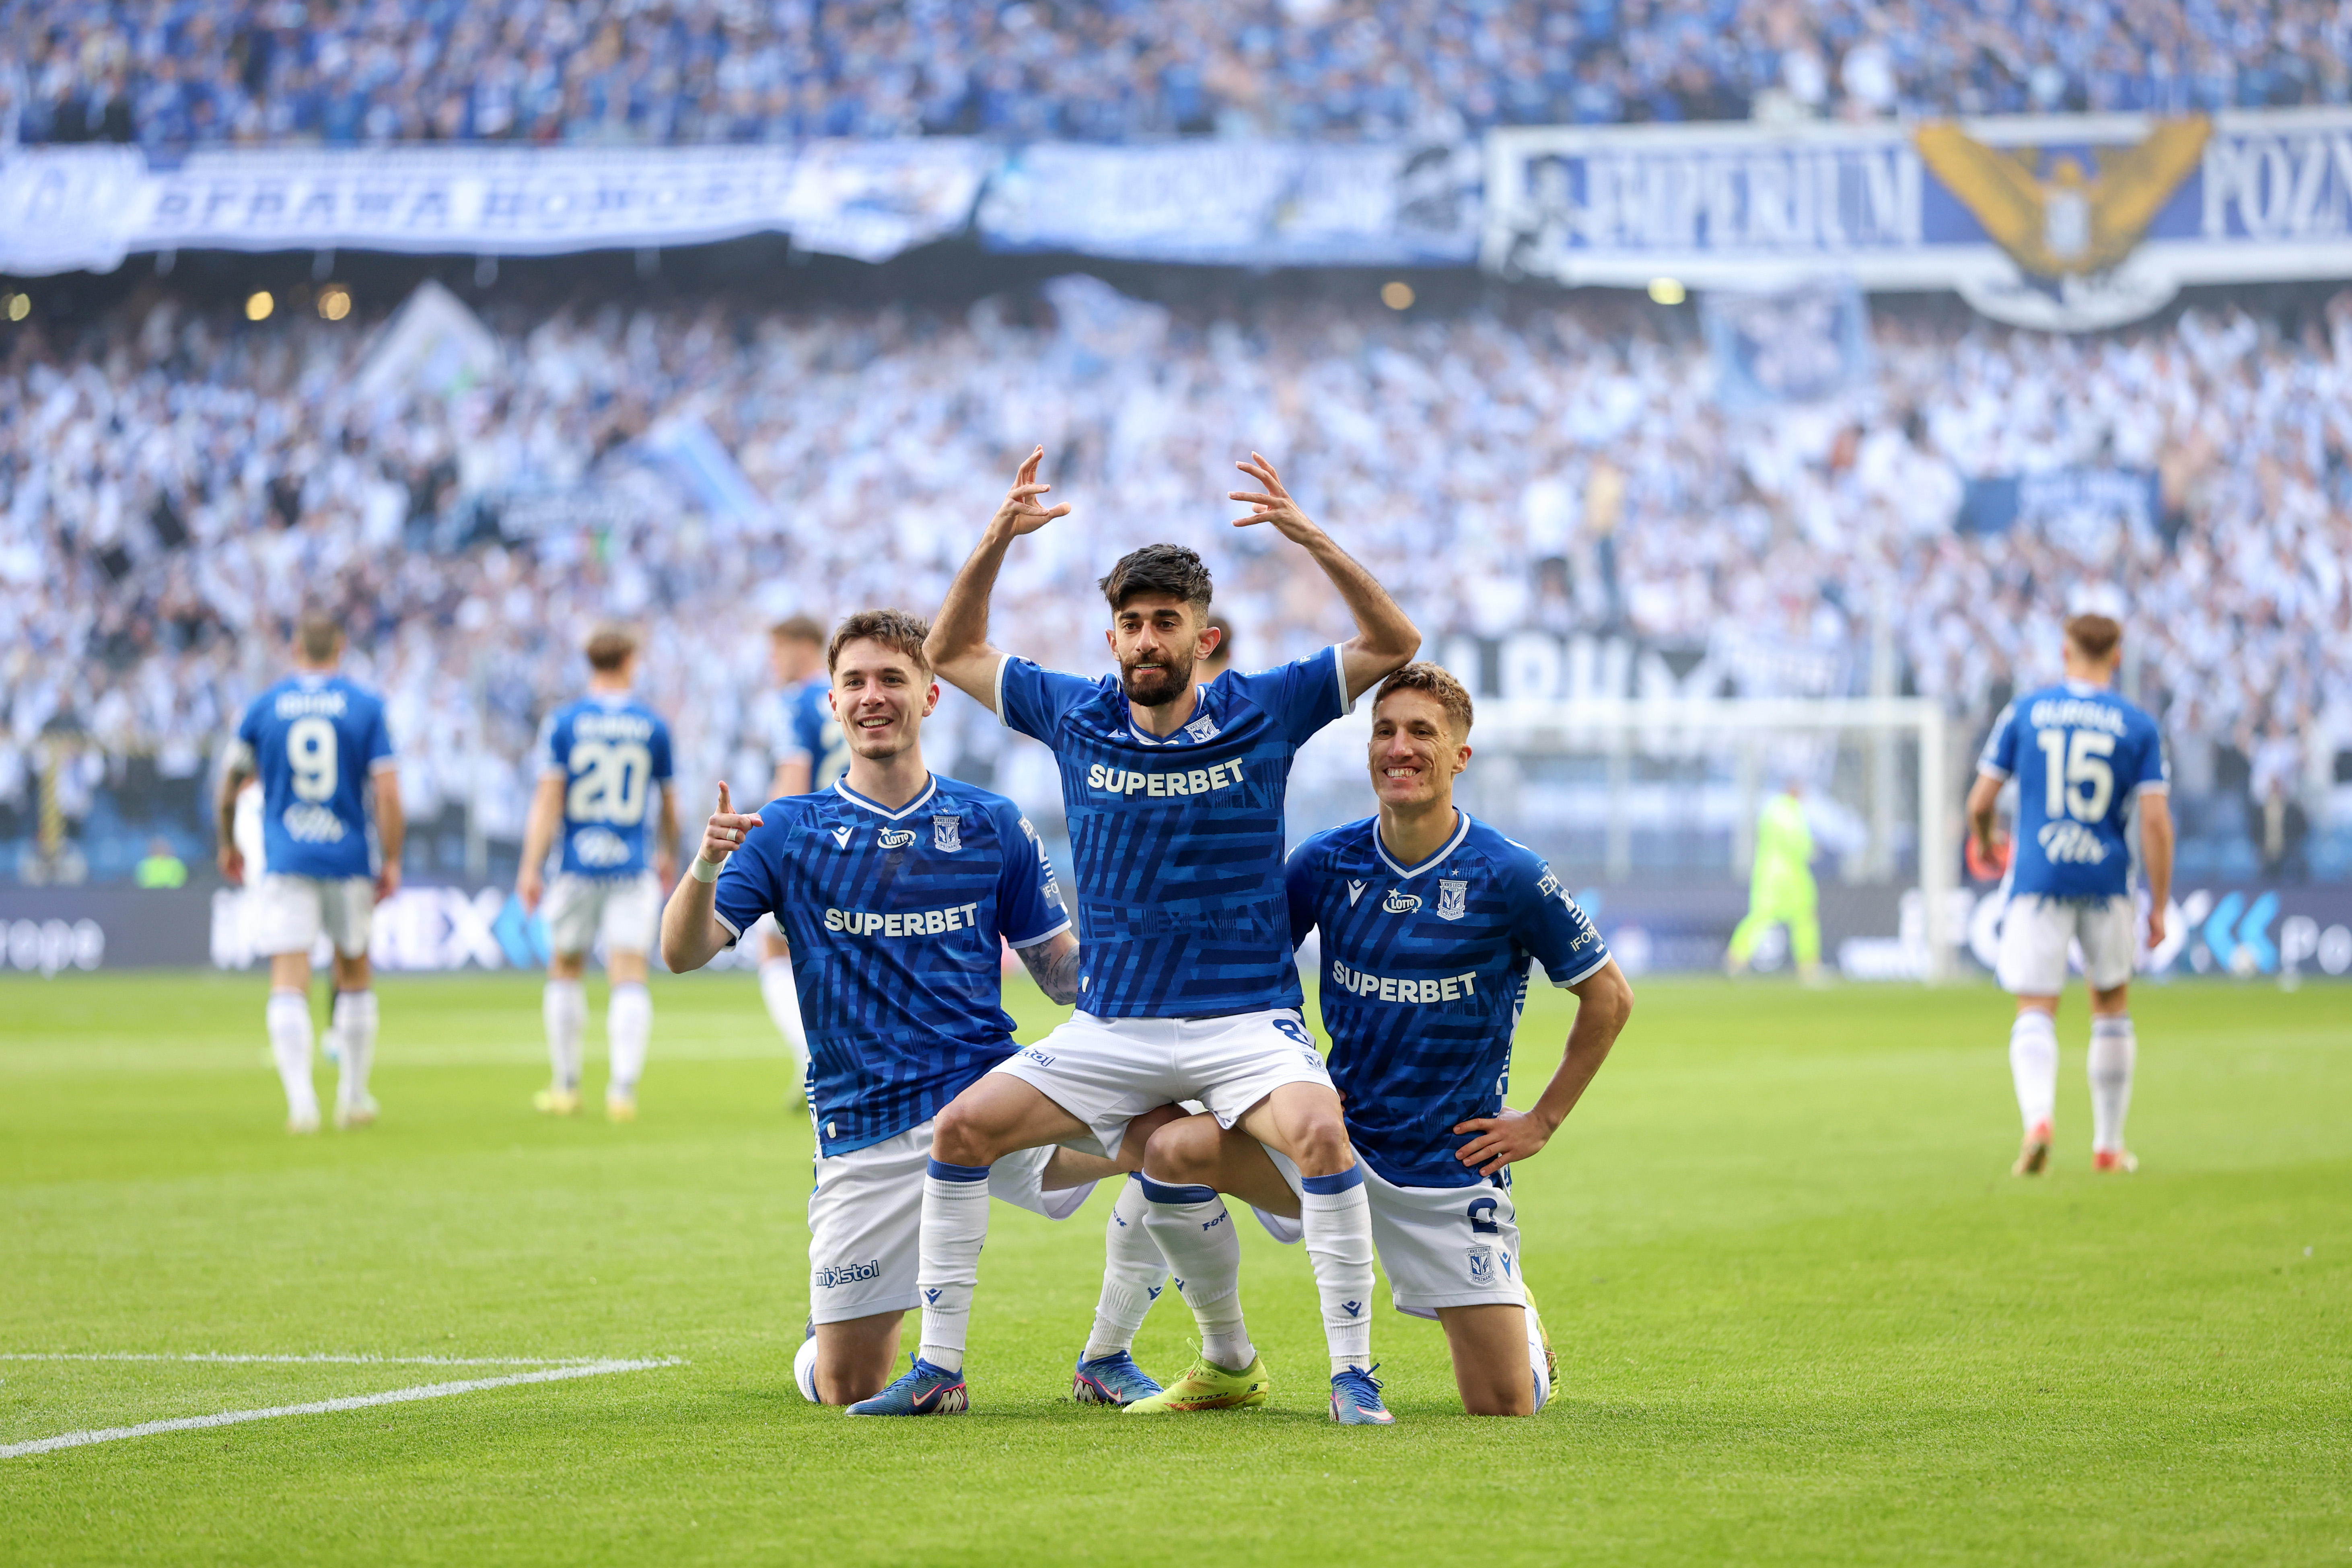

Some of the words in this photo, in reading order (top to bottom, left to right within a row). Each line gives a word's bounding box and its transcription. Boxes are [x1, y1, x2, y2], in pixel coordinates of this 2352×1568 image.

[286, 714, 339, 804] 9
[2036, 727, 2116, 823] 15
[567, 742, 652, 827] 20
[1087, 757, 1245, 797] SUPERBET
[884, 833, 909, 845] LOTTO
[823, 902, 978, 937] SUPERBET
[1391, 898, 1415, 910] LOTTO
[1333, 959, 1477, 1004] SUPERBET
[1467, 1198, 1498, 1233] 2
[815, 1259, 880, 1288] mikstol
[1181, 1392, 1229, 1401] FURON
